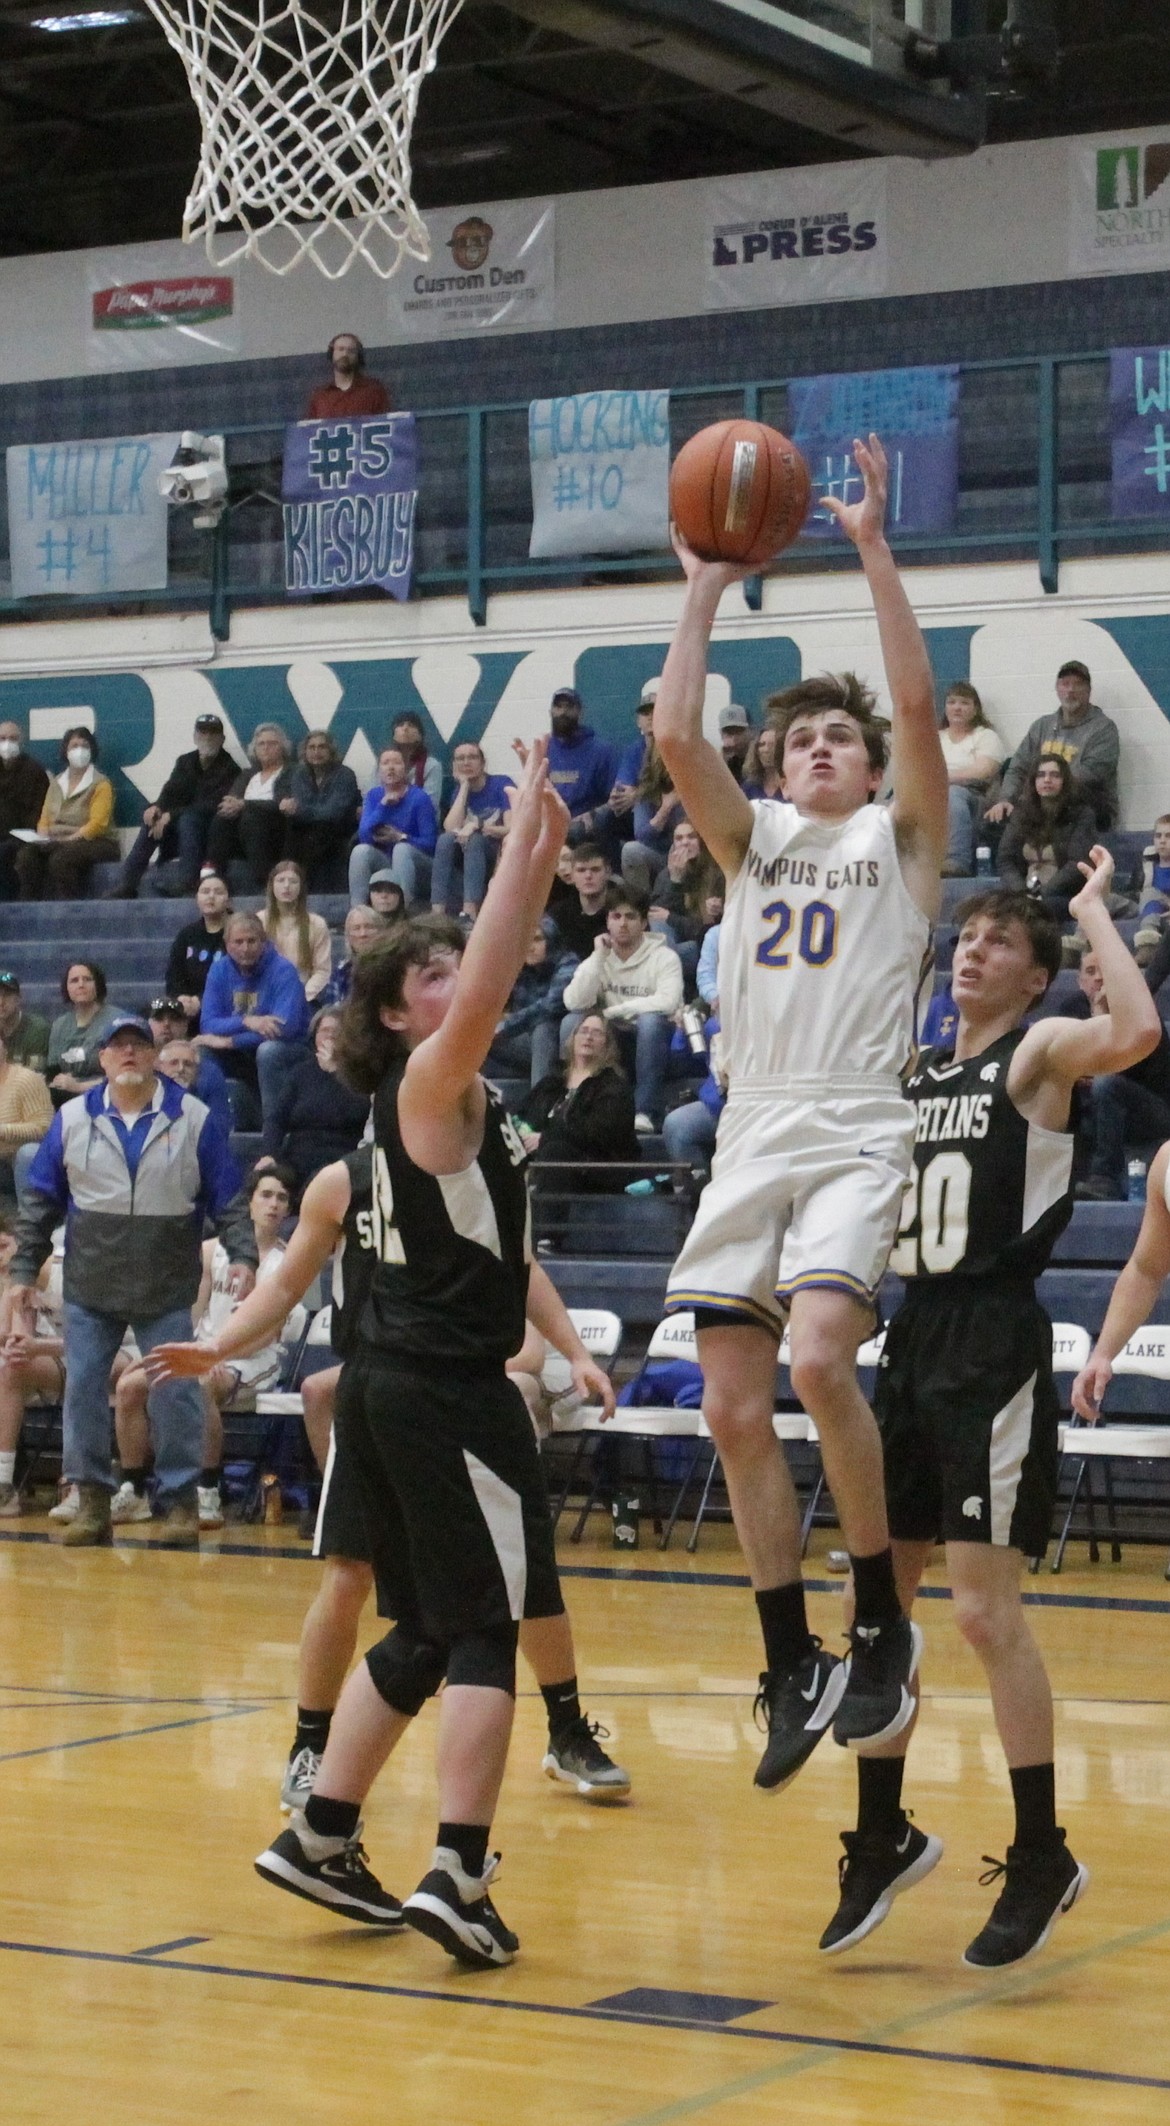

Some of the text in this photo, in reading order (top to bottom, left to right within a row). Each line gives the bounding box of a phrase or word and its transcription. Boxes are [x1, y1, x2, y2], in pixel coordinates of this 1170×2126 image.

[742, 221, 877, 264] PRESS
[489, 266, 525, 287] Den
[530, 392, 670, 461] HOCKING
[308, 422, 393, 490] #5
[27, 442, 150, 520] MILLER
[553, 464, 623, 512] #10
[37, 527, 112, 585] #4
[282, 490, 418, 591] KIESBUY
[826, 860, 879, 890] CATS
[755, 899, 840, 970] 20
[914, 1094, 993, 1143] RTANS
[580, 1327, 607, 1340] CITY
[663, 1328, 695, 1343] LAKE
[1053, 1340, 1076, 1354] ITY
[1125, 1343, 1165, 1358] LAKE
